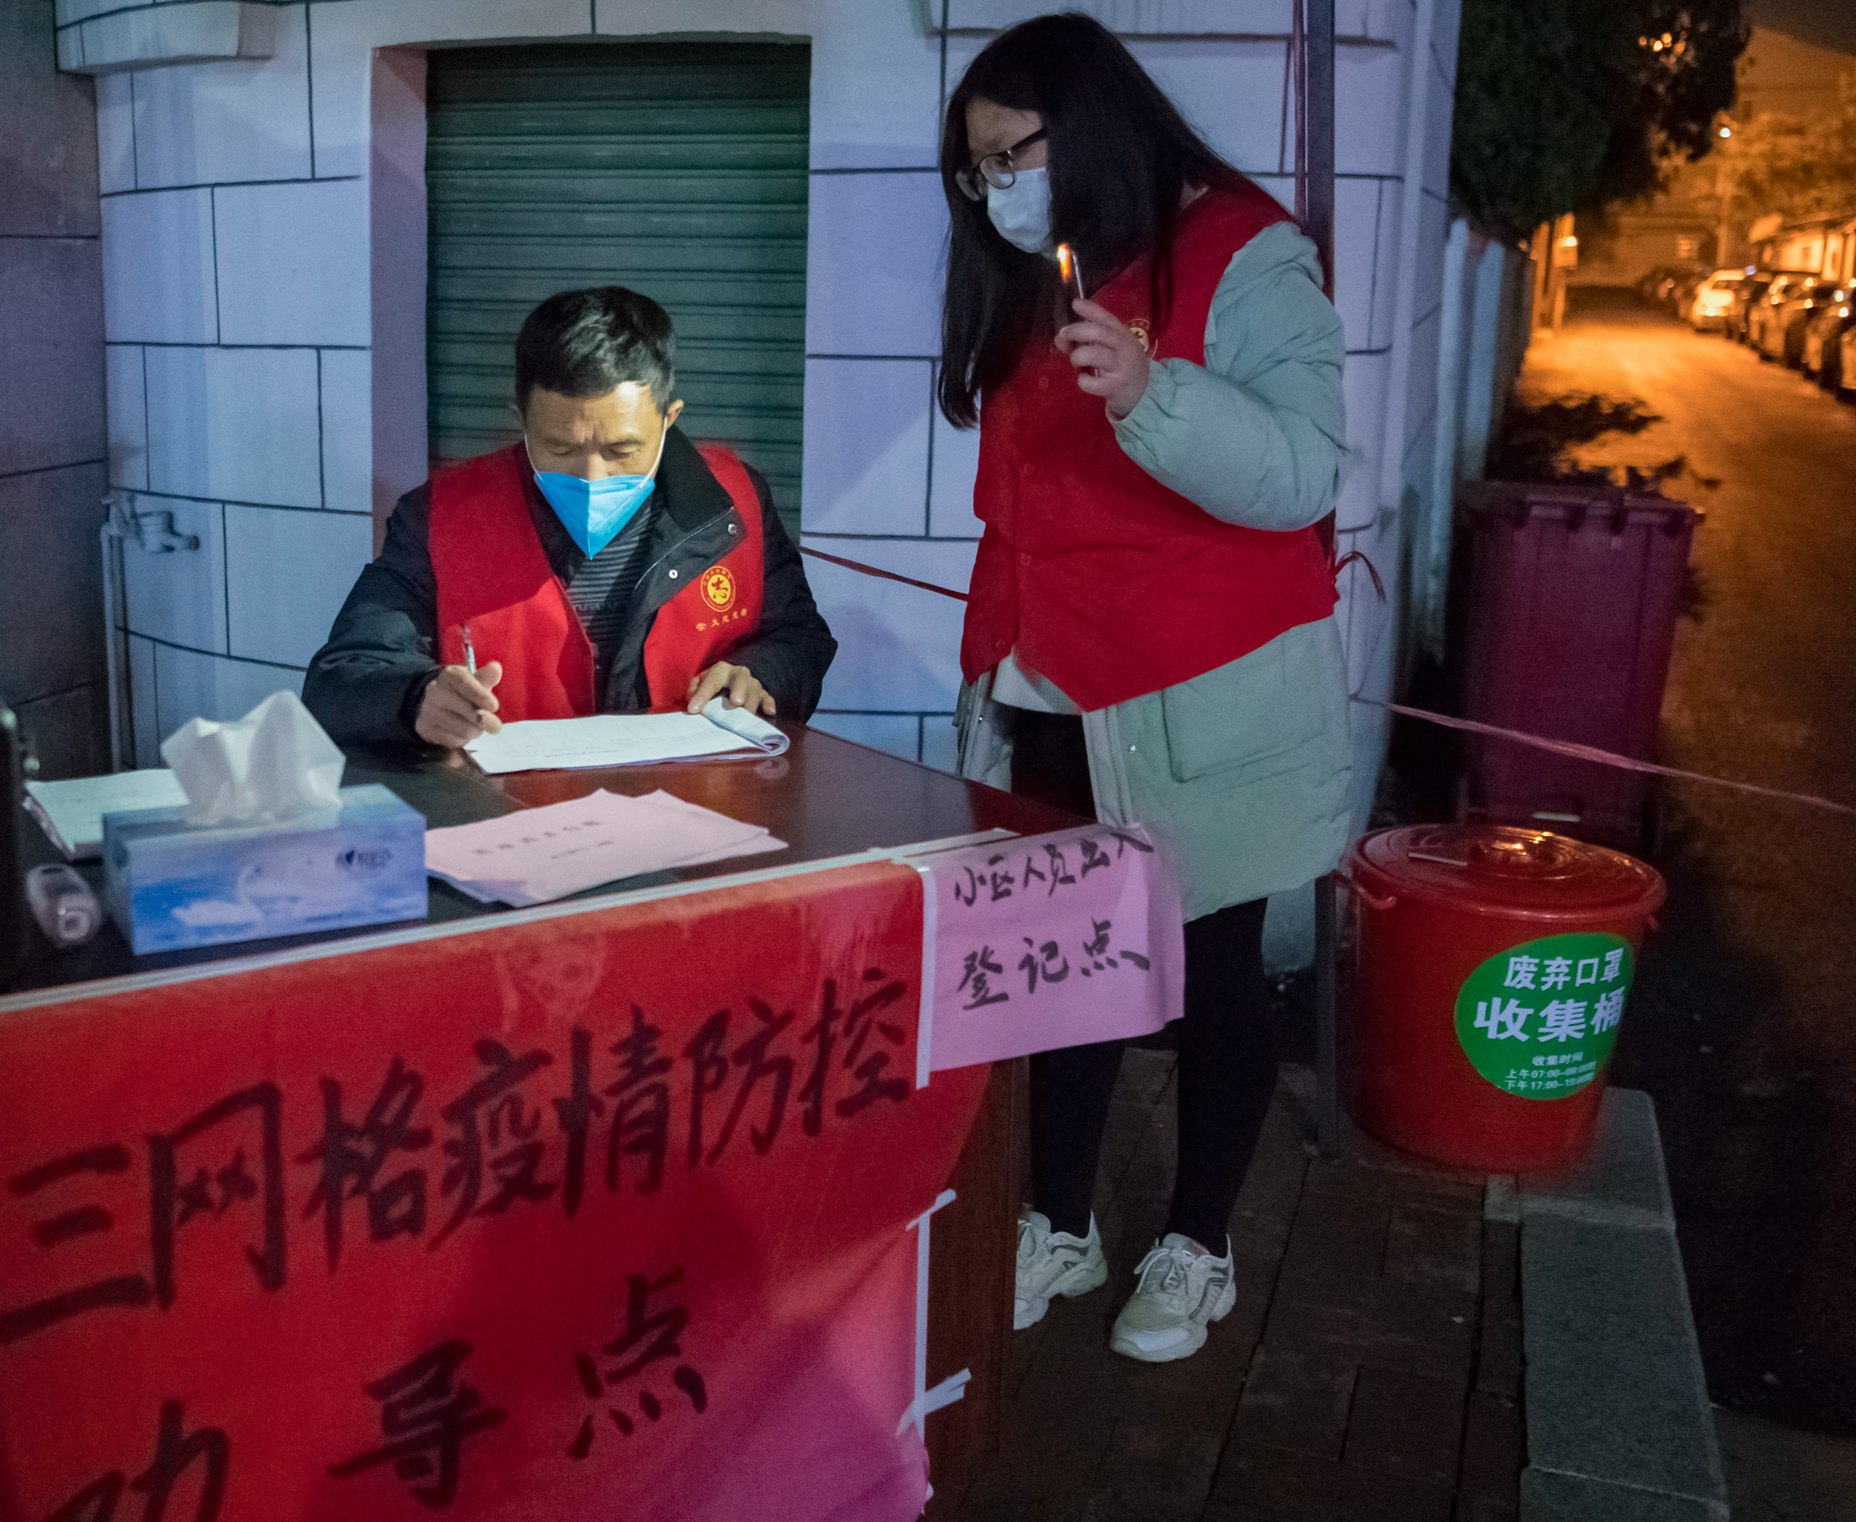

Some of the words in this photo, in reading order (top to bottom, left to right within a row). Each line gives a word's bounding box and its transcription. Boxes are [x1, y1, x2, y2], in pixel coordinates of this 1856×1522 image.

[956, 916, 1151, 1011] 登记点
[1503, 947, 1624, 991] 废弃口罩
[1473, 985, 1626, 1043] 收集桶
[0, 969, 912, 1346] 三网格疫情防控
